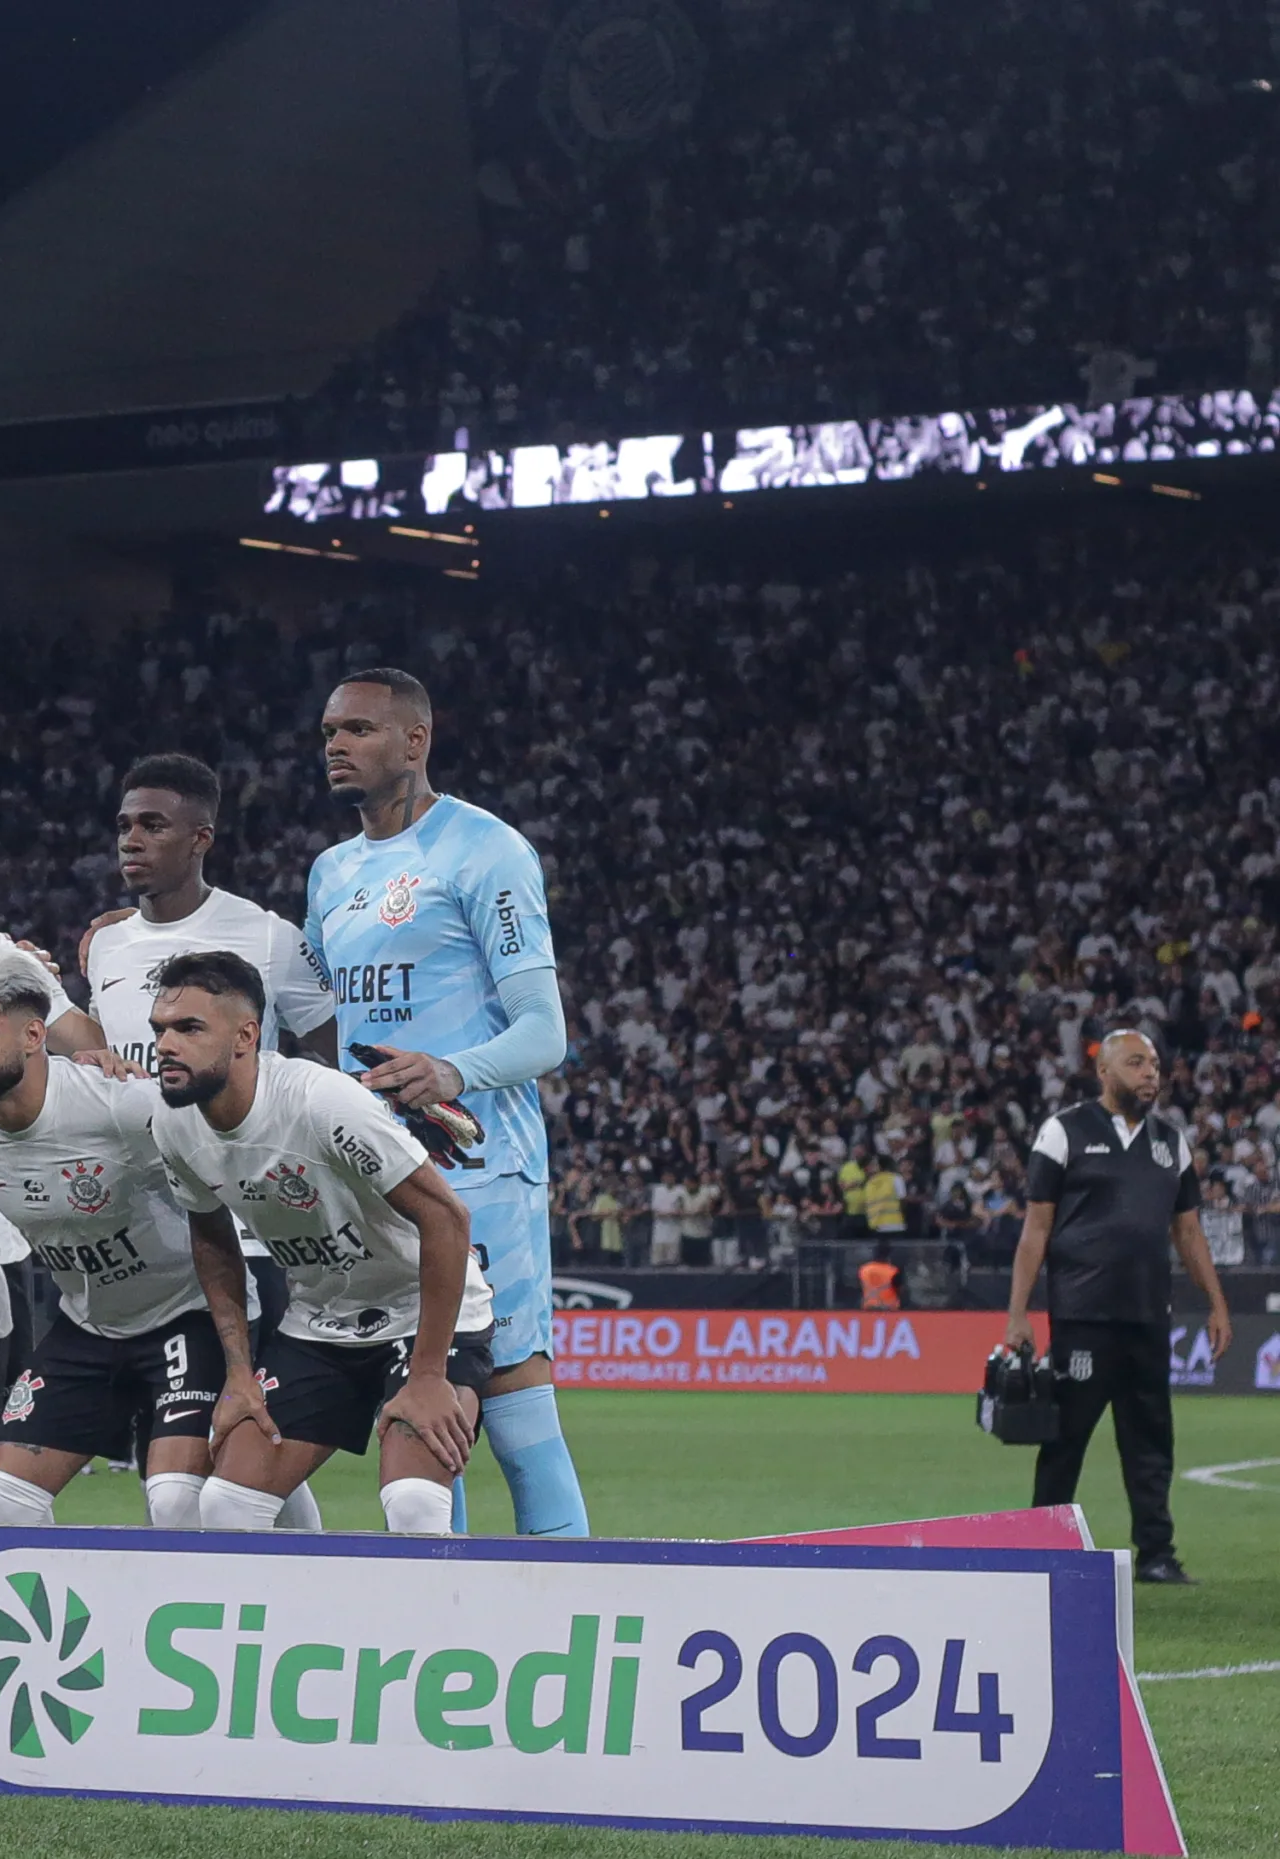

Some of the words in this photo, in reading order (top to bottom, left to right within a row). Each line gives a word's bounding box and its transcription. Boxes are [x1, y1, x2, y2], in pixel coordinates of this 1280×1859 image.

[497, 904, 521, 957] bmg
[341, 1135, 383, 1177] bmg
[23, 1194, 51, 1202] ALE
[242, 1193, 267, 1201] ALE
[164, 1334, 188, 1379] 9
[695, 1316, 921, 1360] LARANJA
[587, 1361, 690, 1382] COMBATE
[716, 1361, 829, 1385] LEUCEMIA
[137, 1601, 645, 1757] Sicredi
[676, 1629, 1015, 1764] 2024
